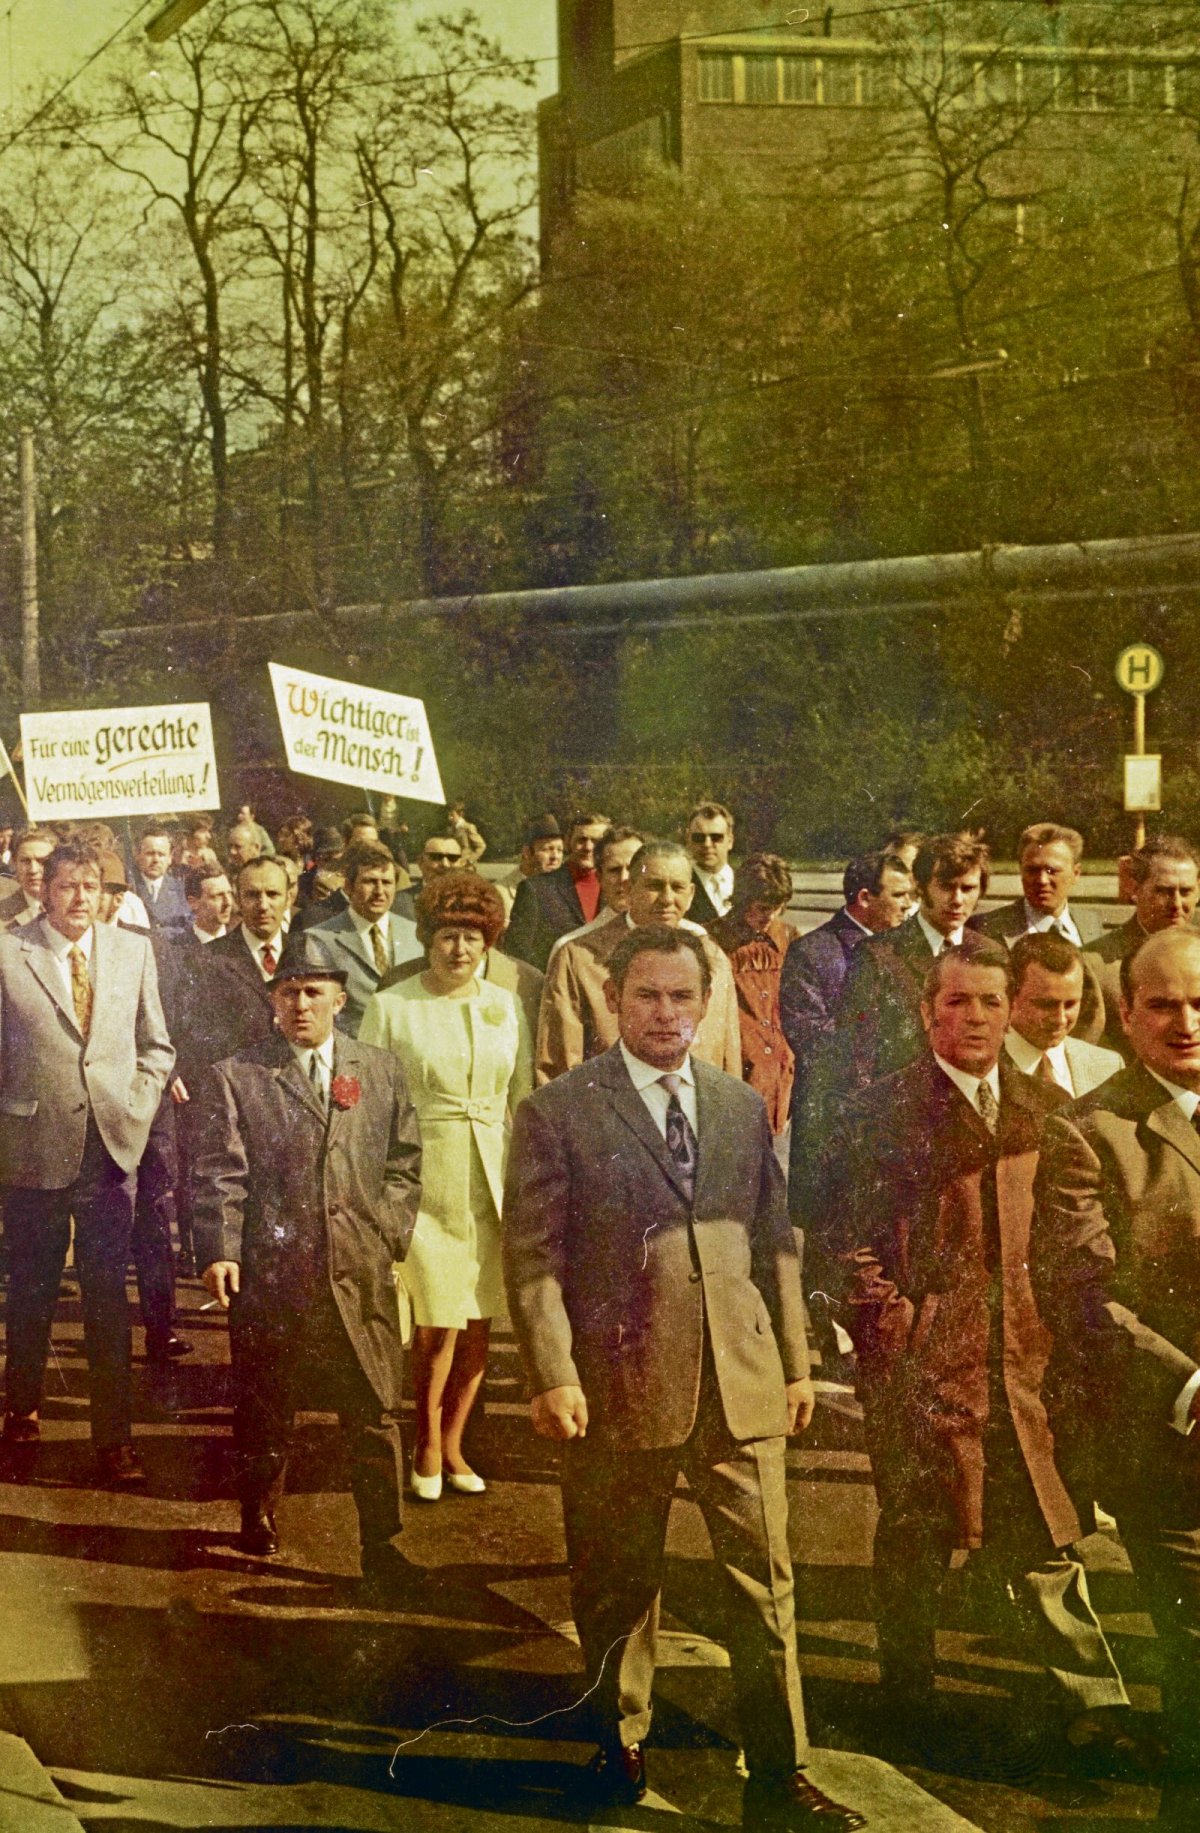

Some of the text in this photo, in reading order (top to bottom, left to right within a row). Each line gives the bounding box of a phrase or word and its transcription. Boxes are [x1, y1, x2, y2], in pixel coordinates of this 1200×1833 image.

[1128, 654, 1151, 684] H
[286, 683, 421, 743] Wichtiger ist
[30, 716, 199, 765] Für eine gerechte
[293, 739, 318, 759] der
